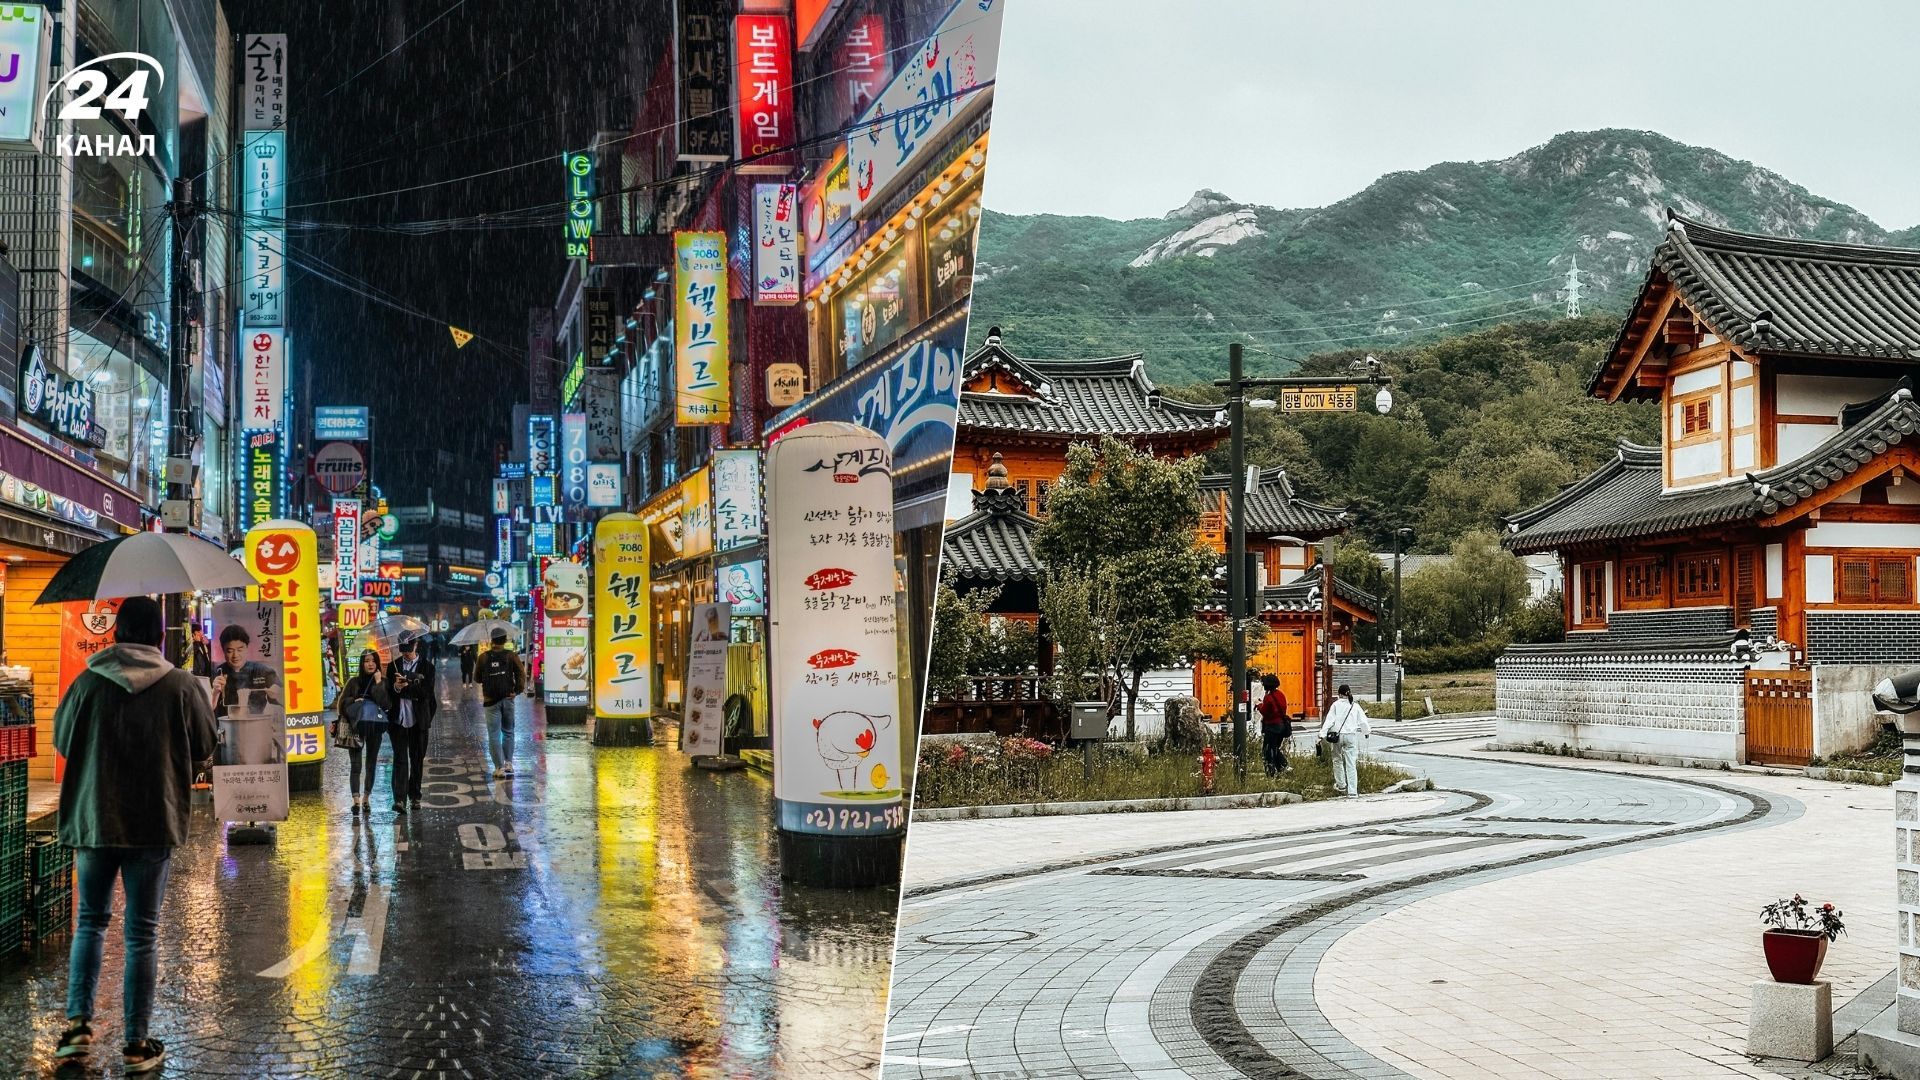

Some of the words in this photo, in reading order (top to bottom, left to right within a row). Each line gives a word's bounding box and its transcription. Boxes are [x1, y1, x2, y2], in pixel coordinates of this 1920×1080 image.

[749, 25, 779, 138] 보드게임
[261, 162, 269, 217] LOCOCO
[570, 155, 592, 239] GLOW
[567, 243, 589, 256] BA
[692, 249, 719, 258] 7080
[258, 237, 269, 289] 로코코
[693, 262, 724, 270] 라이브
[250, 292, 278, 310] 헤어
[686, 282, 718, 389] 쉘브르
[255, 355, 270, 419] 한신포차
[774, 377, 799, 387] Asahi
[688, 404, 709, 415] 지하
[1285, 394, 1301, 408] 방범
[1305, 394, 1325, 408] CCTV
[1328, 393, 1353, 408] 작동중
[316, 462, 362, 473] Fruits
[569, 428, 584, 502] 7080
[253, 449, 271, 526] 노래연습장
[804, 510, 842, 522] 신선한
[848, 506, 873, 526] 닭이
[619, 544, 642, 552] 7080
[810, 534, 831, 547] 농장
[837, 532, 857, 546] 직송
[617, 556, 644, 564] 라이브
[364, 582, 391, 596] DVD
[813, 571, 847, 590] 무제한
[804, 592, 866, 611] 숯불닭갈비
[344, 607, 367, 626] DVD
[258, 606, 272, 657] 백종원
[607, 572, 643, 683] 쉘브르
[76, 637, 114, 654] 역전우
[815, 651, 854, 669] 무제한
[805, 673, 839, 686] 참이슬
[847, 670, 880, 687] 생맥주
[615, 699, 635, 709] 지하
